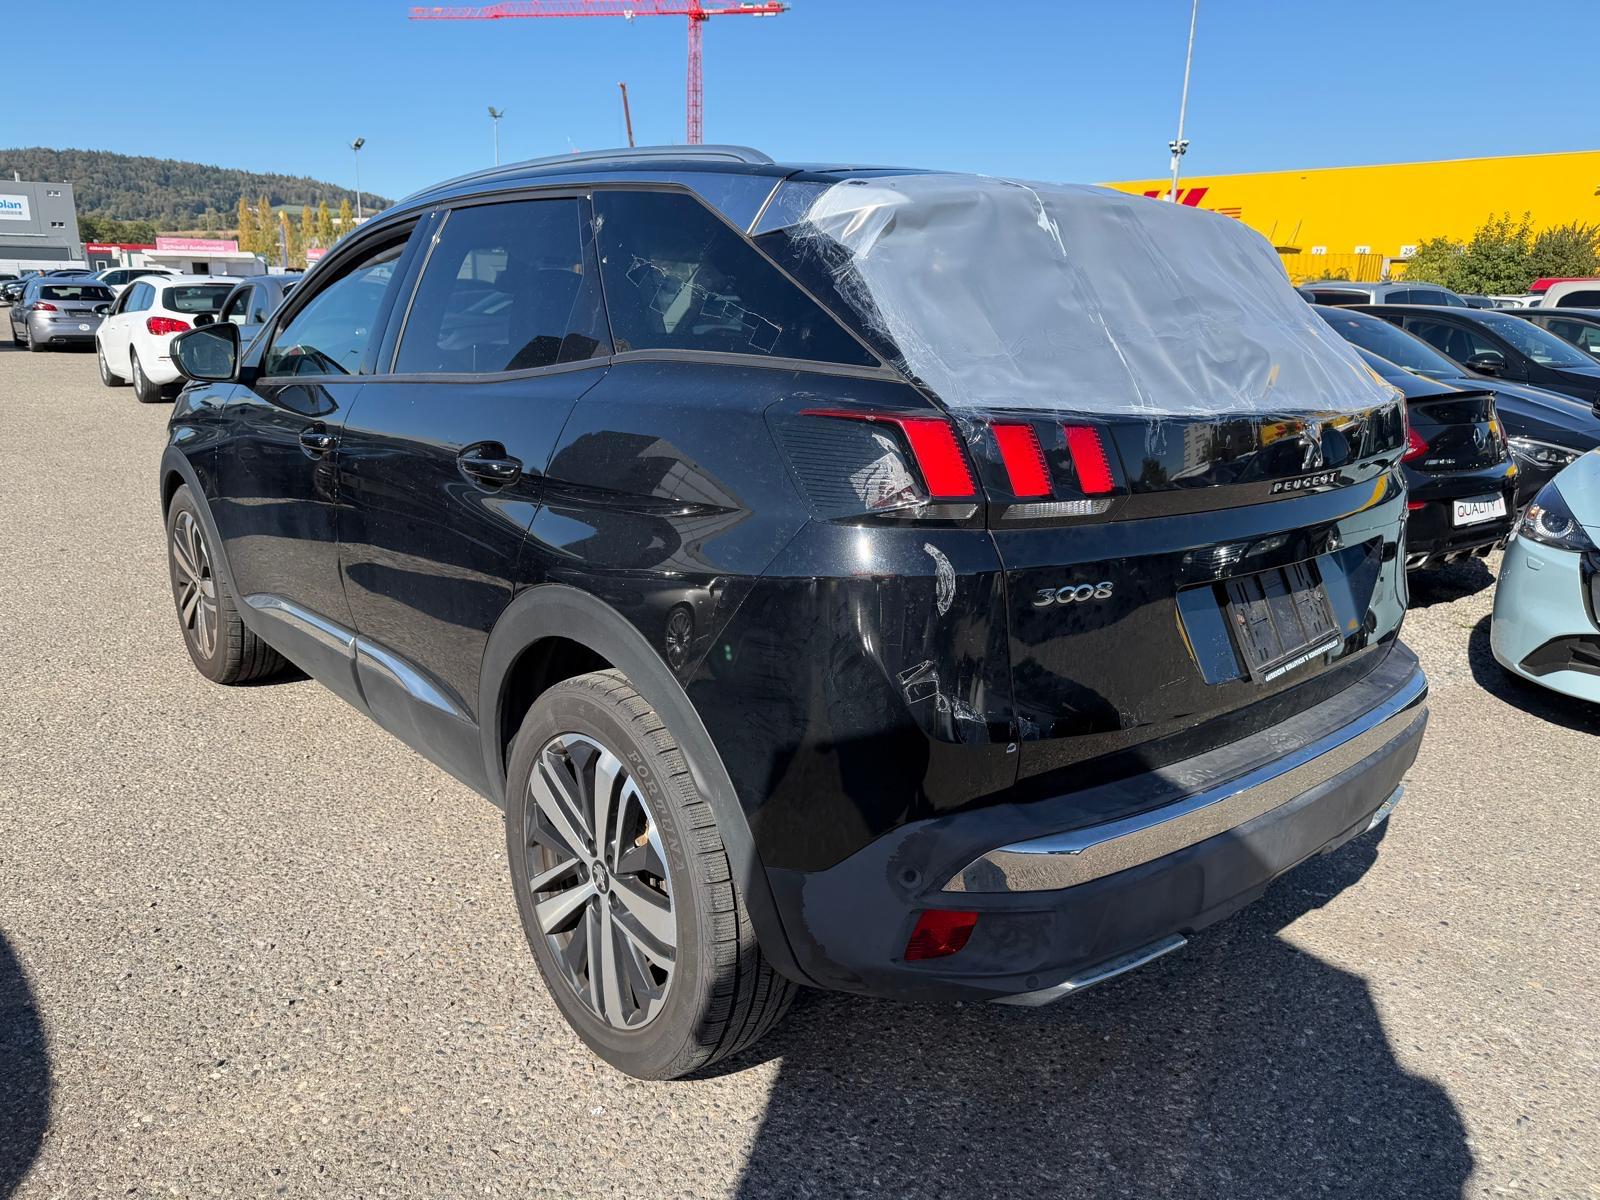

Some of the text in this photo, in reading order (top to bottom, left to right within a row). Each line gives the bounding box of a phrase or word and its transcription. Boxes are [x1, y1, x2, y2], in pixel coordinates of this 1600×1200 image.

[1273, 472, 1337, 493] PEUGEOT
[1457, 501, 1495, 517] QUALITY
[1033, 581, 1114, 608] 3008
[626, 750, 686, 872] FORTUNA
